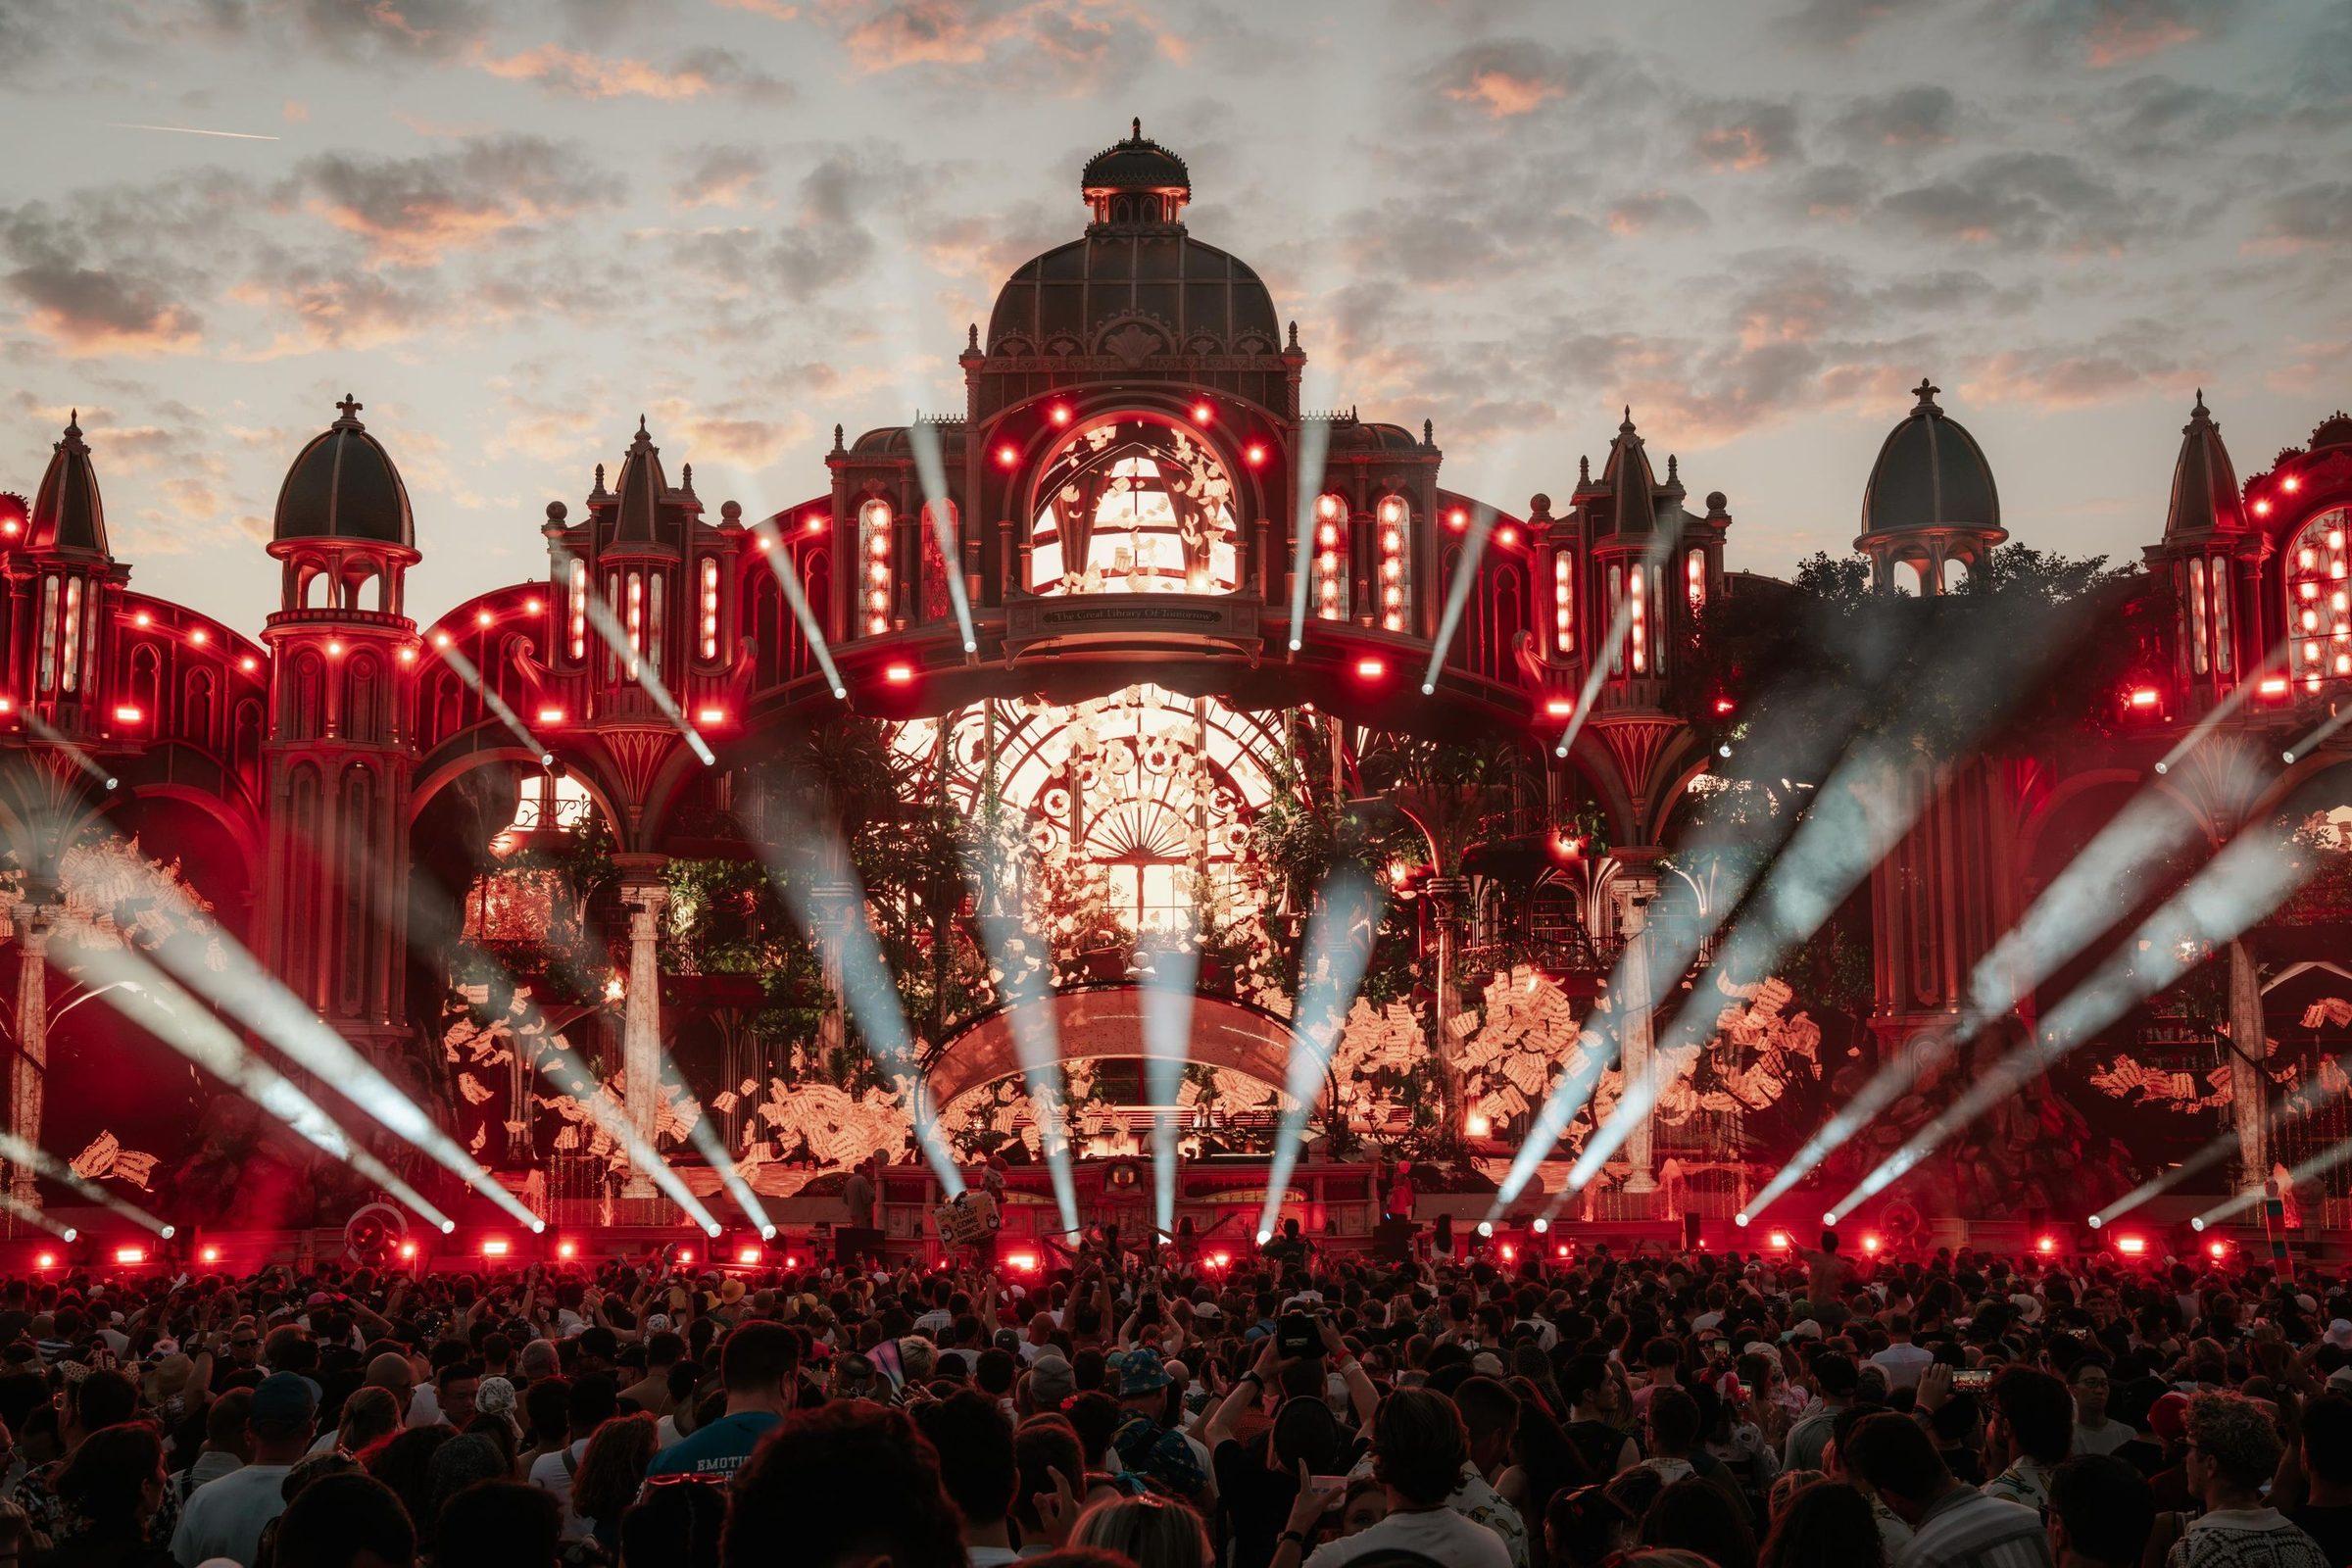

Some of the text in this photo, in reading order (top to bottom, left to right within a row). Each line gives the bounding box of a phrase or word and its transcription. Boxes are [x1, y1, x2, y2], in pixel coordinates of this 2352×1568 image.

[1054, 609, 1210, 621] The Great Library Of Tomorrow
[958, 1206, 978, 1219] LOST
[956, 1215, 979, 1229] COME
[956, 1223, 982, 1238] DANCE
